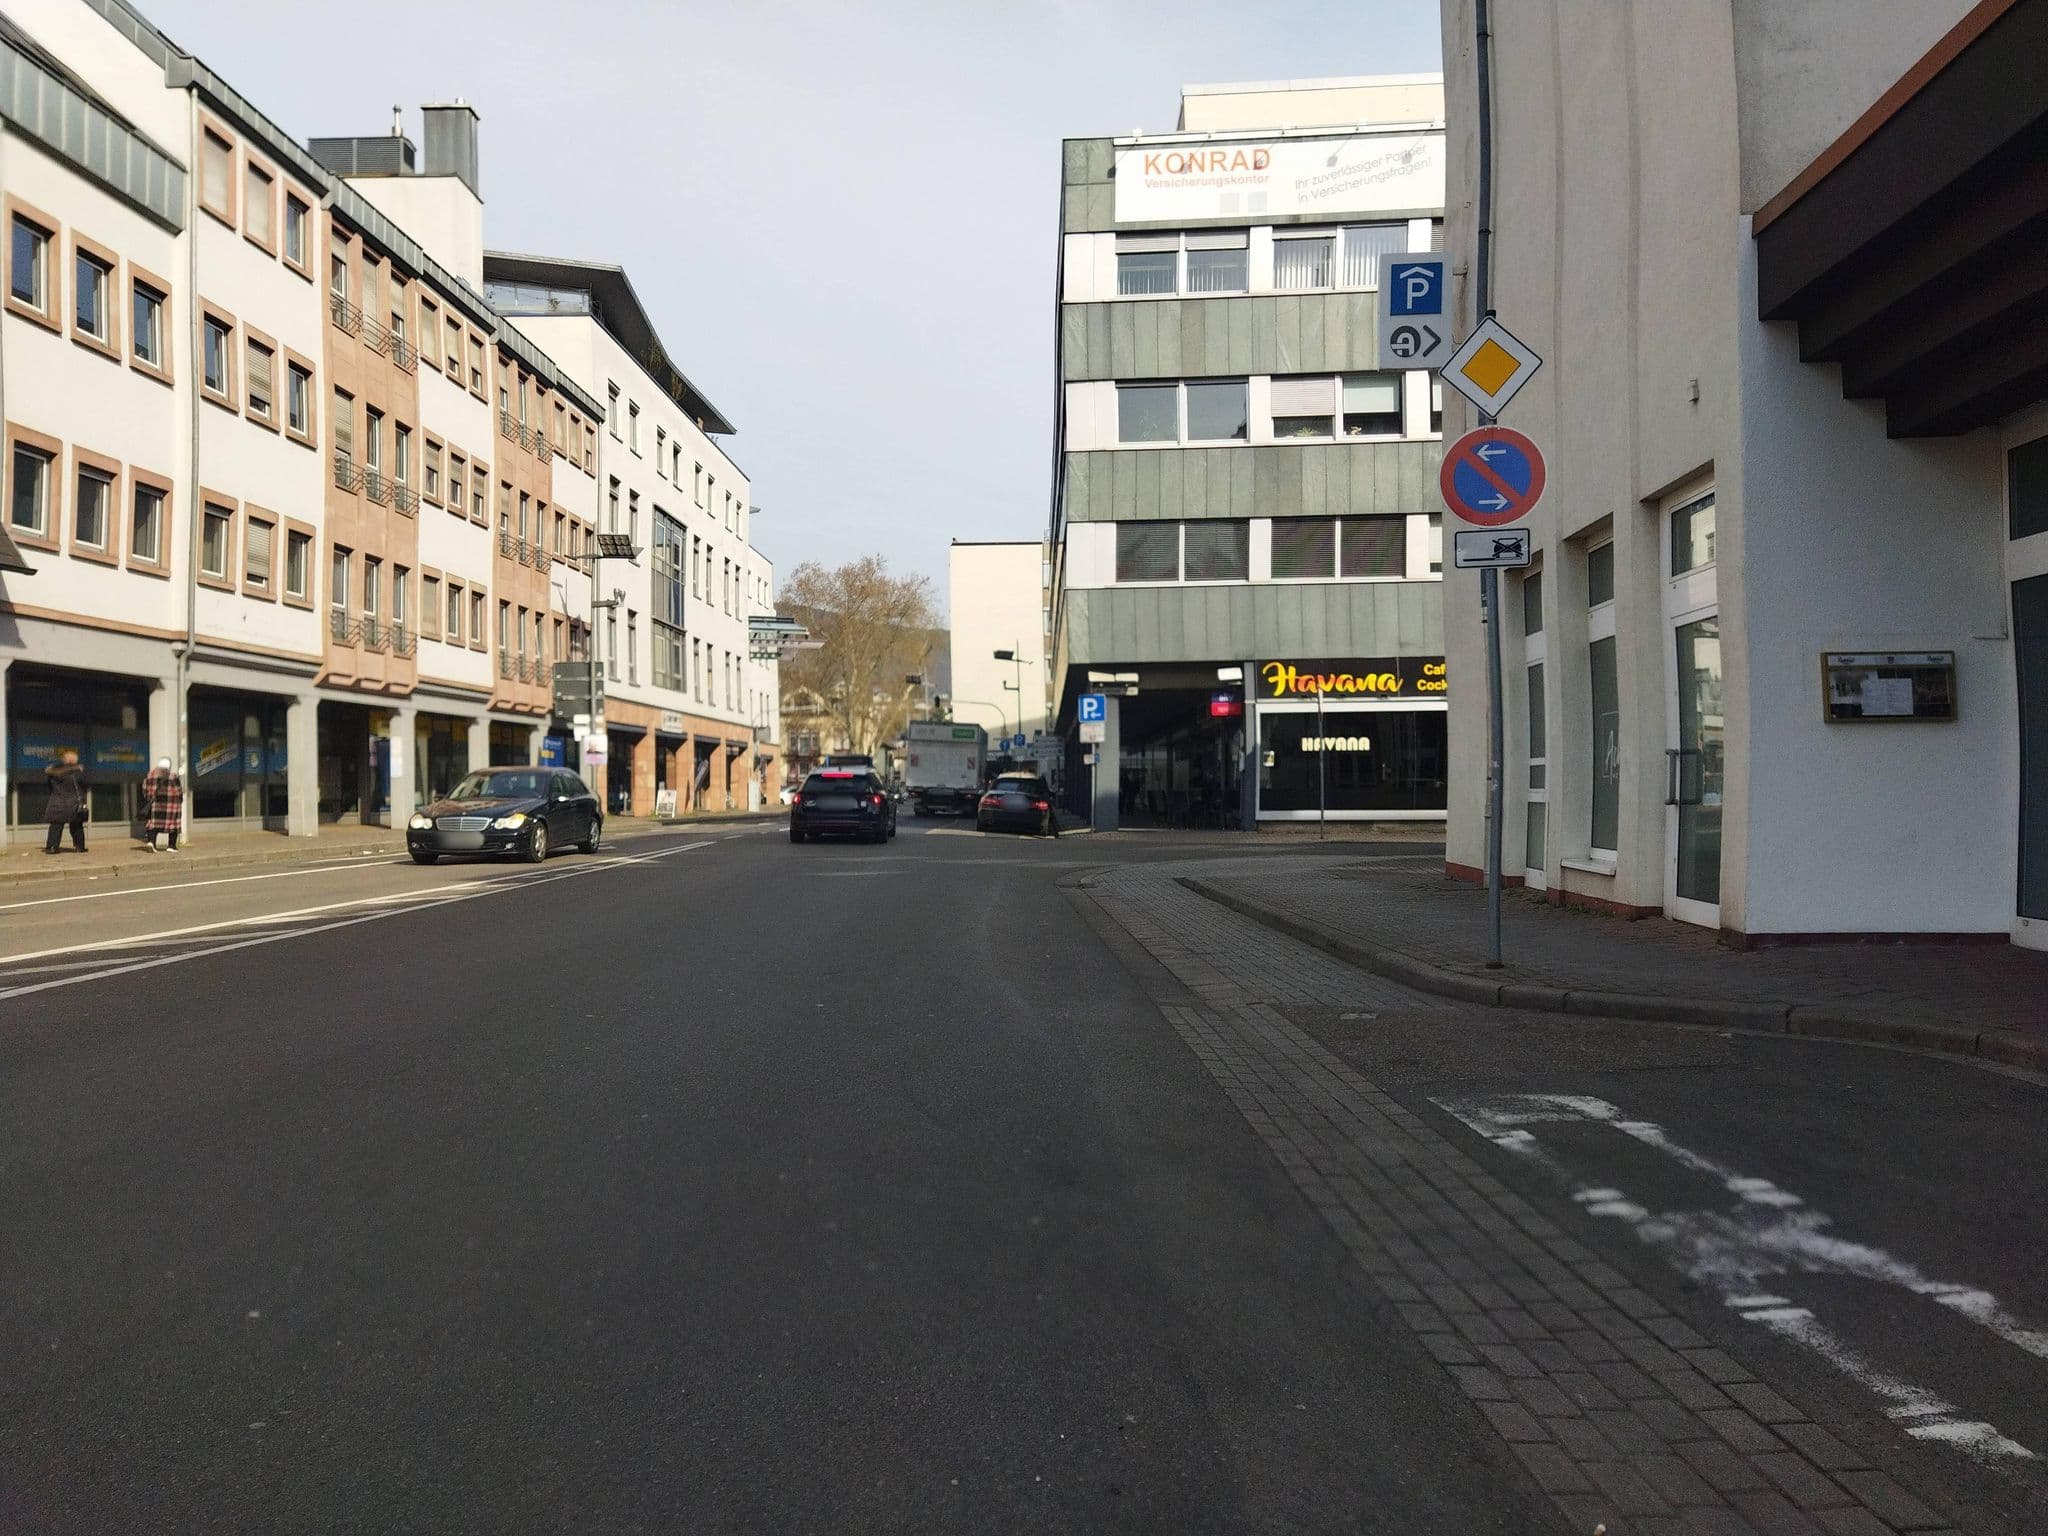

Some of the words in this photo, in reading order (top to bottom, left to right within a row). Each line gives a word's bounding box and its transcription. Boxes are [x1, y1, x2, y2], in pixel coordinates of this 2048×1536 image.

[1144, 148, 1271, 175] KONRAD
[1144, 175, 1270, 189] Versicherungskontor
[1295, 177, 1309, 190] Ihr
[1298, 191, 1309, 204] in
[1407, 278, 1429, 309] P
[1263, 661, 1404, 697] Havana
[1083, 698, 1098, 719] P
[1301, 737, 1371, 752] HAVANA
